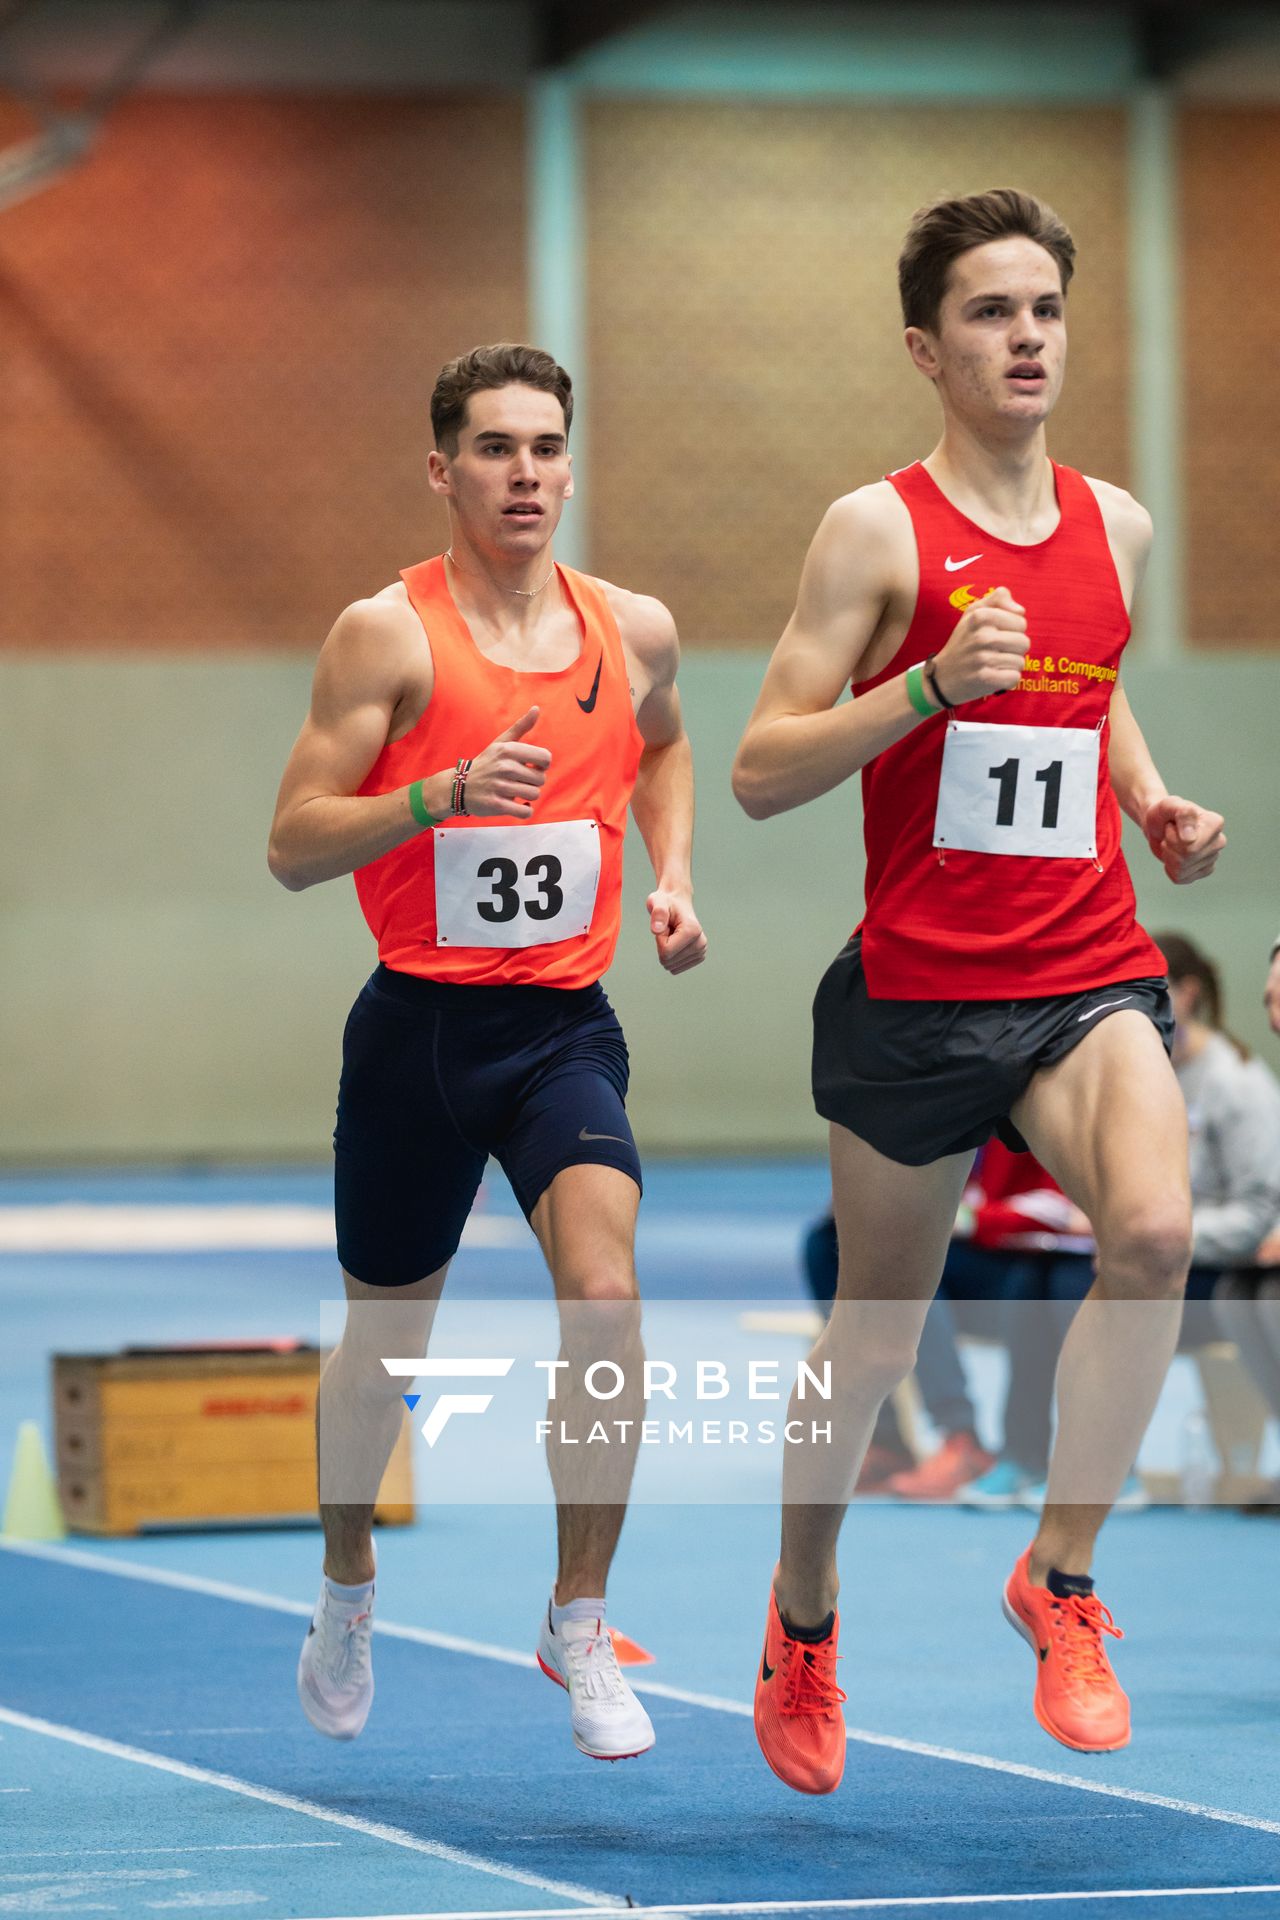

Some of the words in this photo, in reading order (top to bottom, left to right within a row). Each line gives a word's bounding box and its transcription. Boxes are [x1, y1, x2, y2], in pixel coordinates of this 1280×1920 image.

[1010, 675, 1079, 694] nsultants
[1023, 654, 1041, 671] ke
[1043, 656, 1055, 672] &
[1058, 657, 1117, 682] Compagnie
[989, 758, 1063, 829] 11
[477, 854, 564, 923] 33
